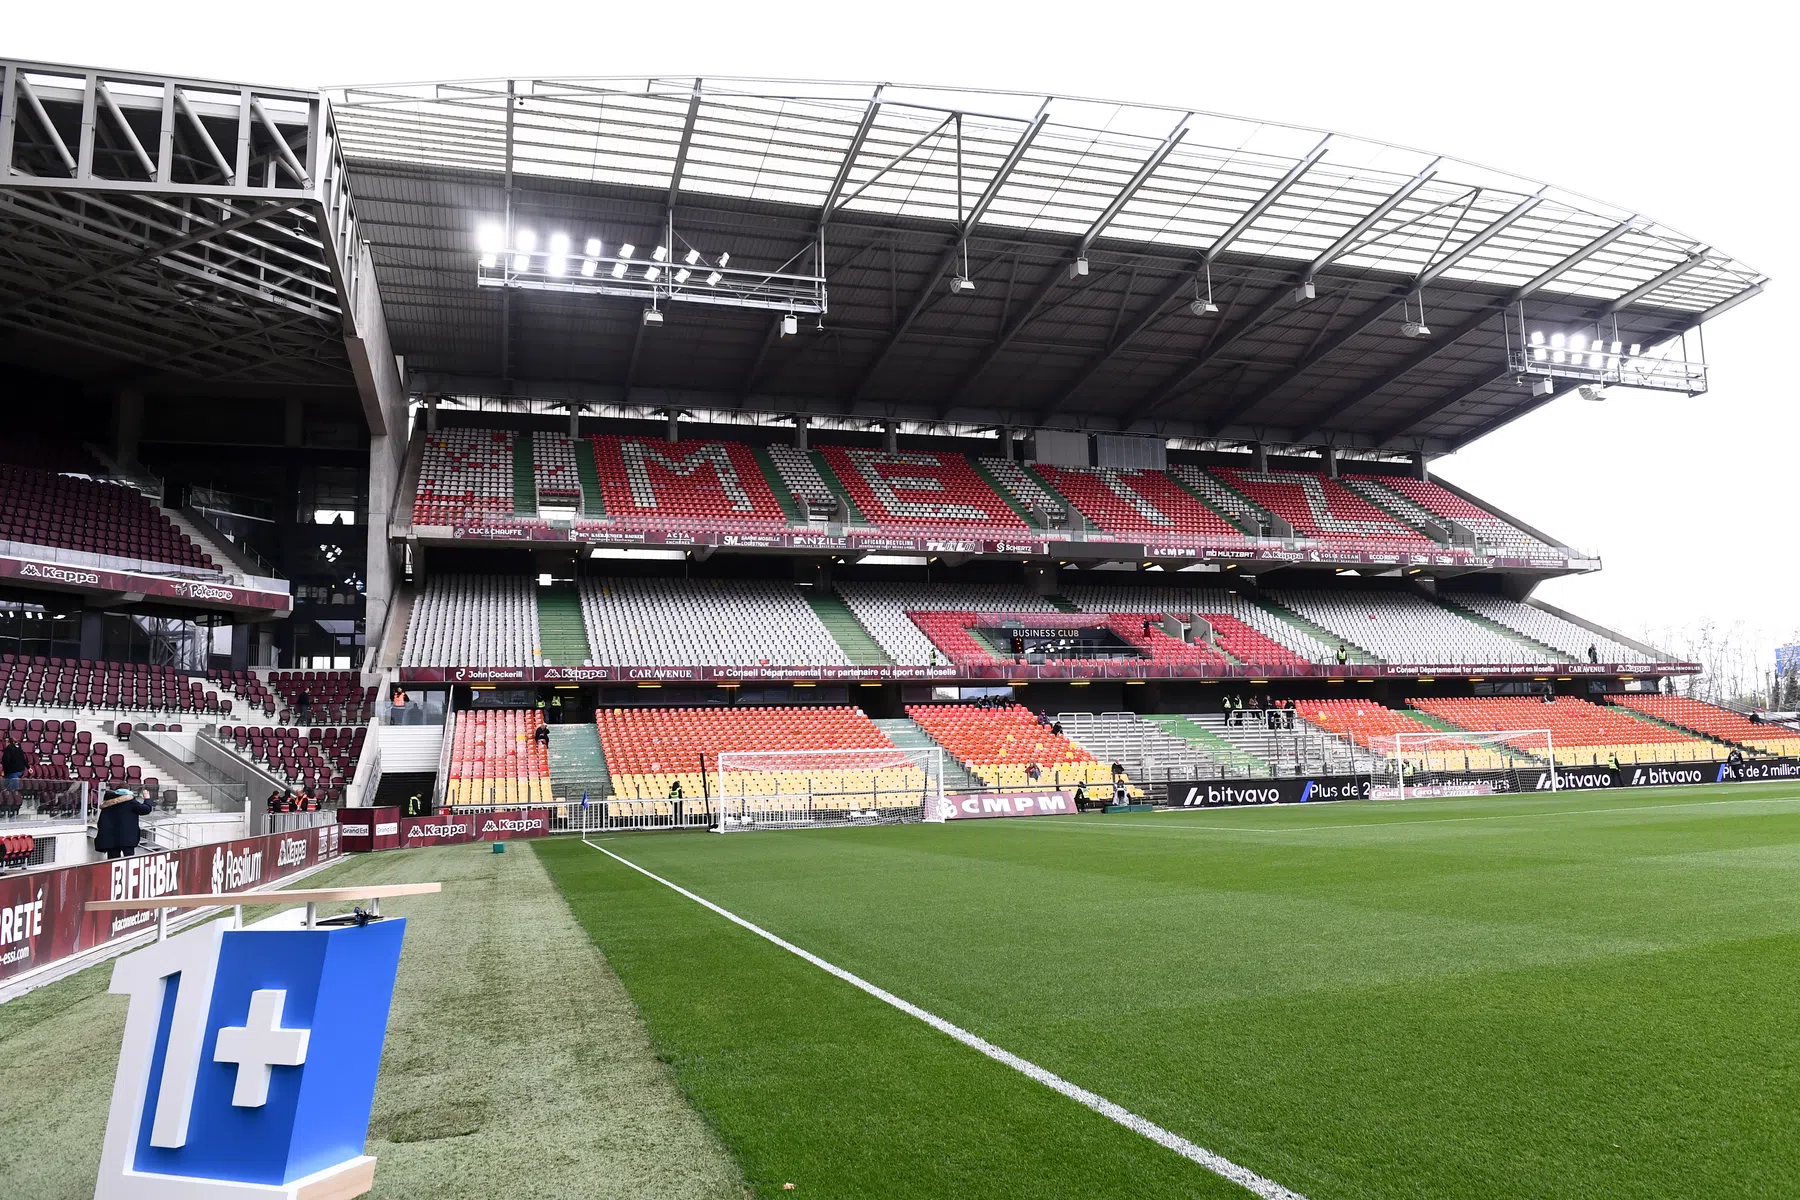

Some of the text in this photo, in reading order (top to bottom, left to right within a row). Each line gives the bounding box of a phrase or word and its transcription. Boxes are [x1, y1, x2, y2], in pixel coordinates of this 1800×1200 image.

[491, 528, 522, 536] CHAUFFE
[1160, 548, 1195, 556] CMPM
[1272, 551, 1304, 560] Kappa
[42, 566, 98, 583] Kappa
[1013, 629, 1056, 637] BUSINESS
[468, 670, 522, 679] John Cockerill
[562, 668, 606, 679] Kappa
[629, 669, 692, 678] CAR AVENUE
[713, 668, 724, 677] Le
[726, 668, 757, 677] Conseil
[760, 668, 820, 679] Départemental
[823, 668, 836, 676] 1er
[838, 668, 878, 678] partenaire
[880, 668, 891, 676] du
[893, 669, 913, 678] sport
[927, 668, 956, 676] Moselle
[1420, 666, 1461, 674] Départemental
[1472, 666, 1500, 674] partenaire
[1510, 666, 1524, 674] sport
[1568, 665, 1582, 673] CAR
[1625, 665, 1651, 673] Kappa
[1649, 768, 1701, 784] bitvavo
[1746, 765, 1759, 777] de
[1762, 765, 1769, 776] 2
[1555, 772, 1610, 788] bitvavo
[1208, 786, 1280, 803] bitvavo
[1310, 783, 1338, 799] Plus
[1342, 783, 1358, 797] de
[1362, 782, 1371, 796] 2
[961, 795, 1066, 814] CMPM
[424, 824, 467, 837] Kappa
[499, 819, 542, 831] Kappa
[286, 838, 306, 866] Kappa
[225, 847, 262, 890] Resilium
[0, 887, 43, 945] RETÉ
[0, 946, 29, 965] -essi.com
